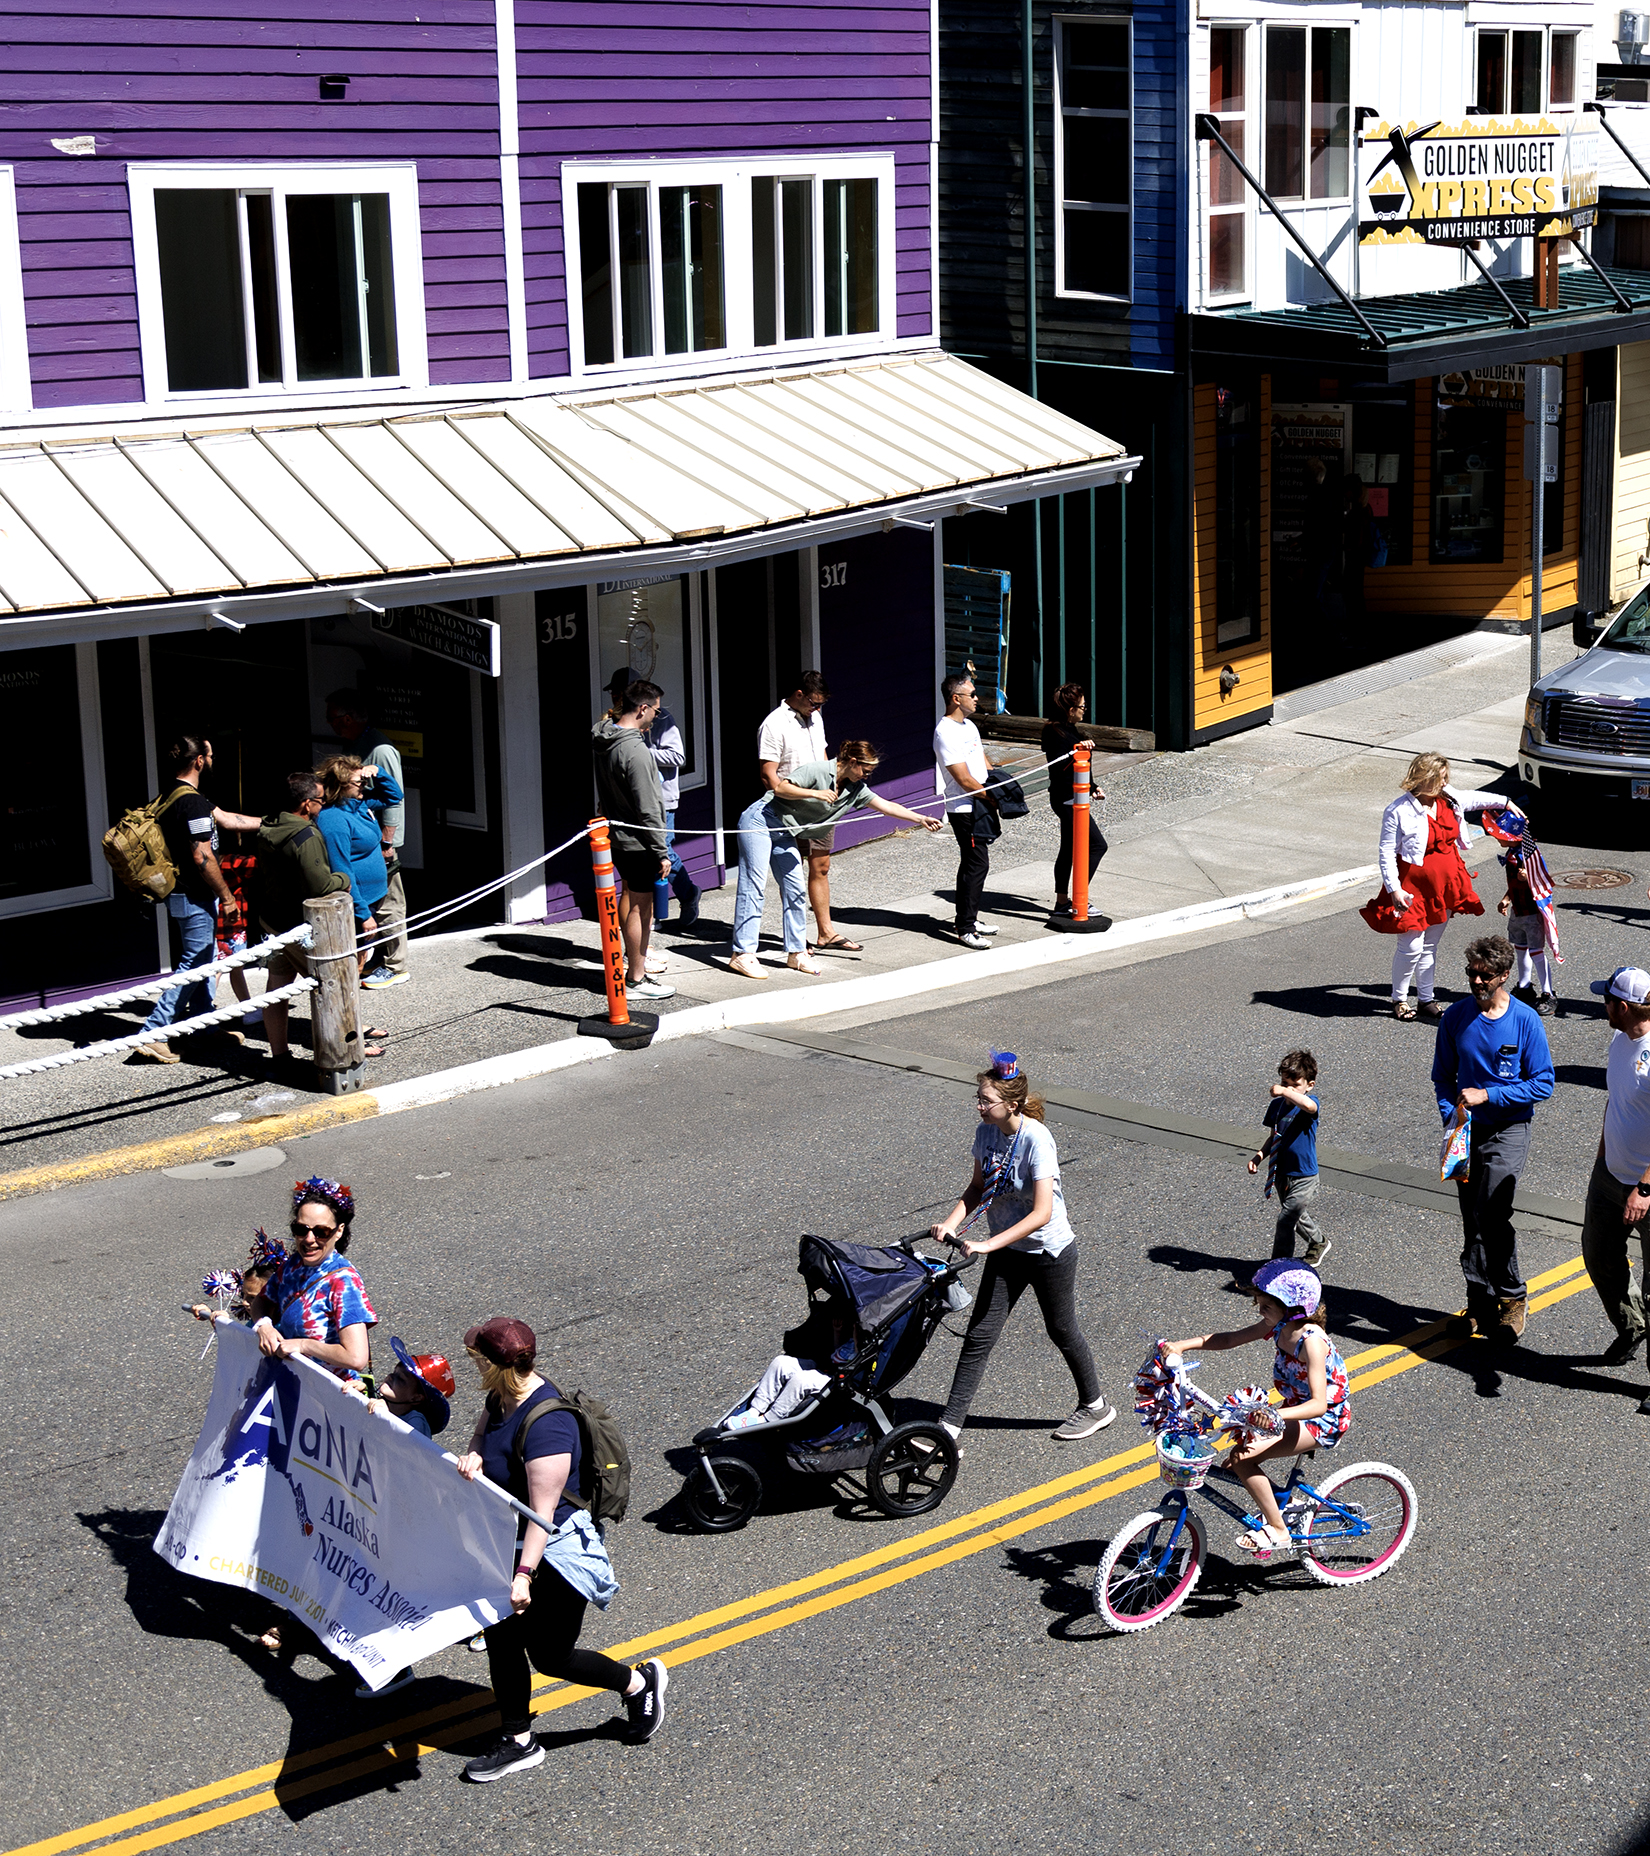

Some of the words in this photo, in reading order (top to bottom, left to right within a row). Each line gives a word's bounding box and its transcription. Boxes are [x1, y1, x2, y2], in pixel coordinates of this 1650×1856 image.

[1424, 144, 1488, 177] GOLDEN
[1494, 141, 1555, 174] NUGGET
[1408, 176, 1556, 220] XPRESS
[1427, 220, 1501, 240] CONVENIENCE
[1504, 218, 1536, 236] STORE
[1475, 364, 1516, 380] GOLDEN
[1466, 379, 1525, 401] XPRE
[1477, 398, 1522, 410] CONVENIENCE
[1284, 437, 1341, 448] XPRESS
[1288, 427, 1314, 438] GOLDEN
[1315, 428, 1341, 439] NUGGET
[622, 574, 673, 588] INTERNATIONAL
[821, 562, 847, 588] 317
[414, 604, 482, 639] DIAMONDS
[416, 619, 479, 648] INTERNATIONAL
[541, 611, 577, 644] 315
[409, 626, 442, 650] WATCH
[443, 640, 452, 653] &
[453, 643, 489, 667] DESIGN
[604, 895, 619, 943] KTN
[611, 951, 625, 998] P&H
[319, 1496, 381, 1560] Alaska
[209, 1555, 289, 1596] CHARTERED
[312, 1532, 377, 1598] Nurses
[643, 1691, 654, 1716] HOKA
